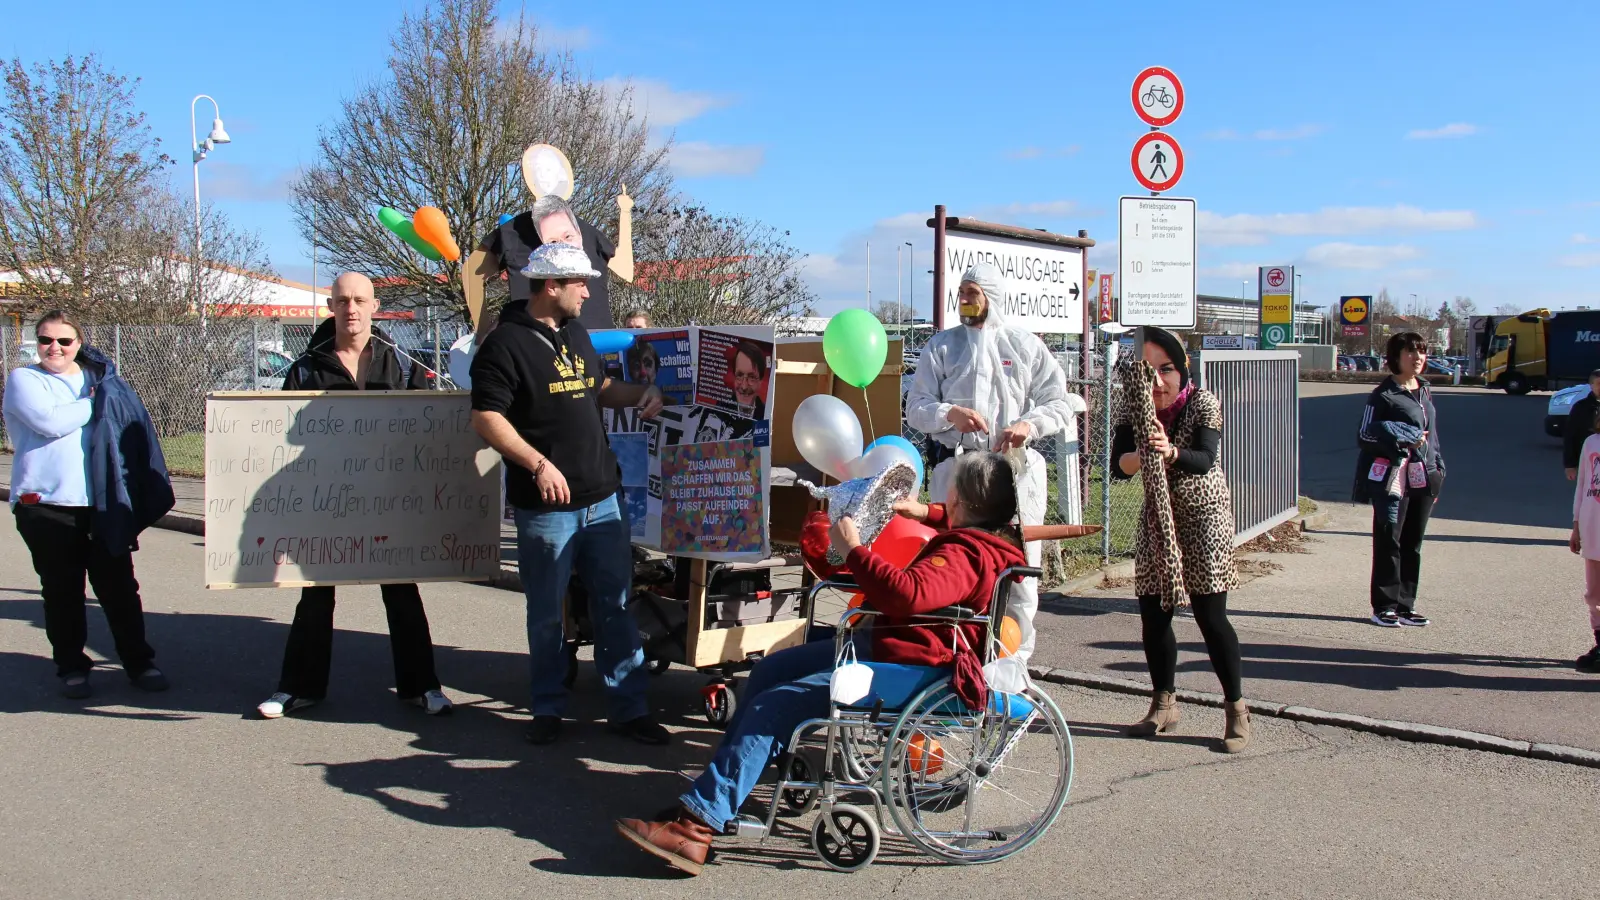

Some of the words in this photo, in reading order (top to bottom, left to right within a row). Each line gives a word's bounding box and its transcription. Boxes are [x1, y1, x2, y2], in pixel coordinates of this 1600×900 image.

[1130, 260, 1143, 274] 10
[675, 340, 690, 352] Wir
[659, 353, 691, 367] schaffen
[677, 367, 692, 379] DAS
[549, 381, 565, 394] EDEL
[208, 406, 240, 433] Nur
[251, 407, 283, 436] eine
[354, 417, 382, 436] nur
[388, 407, 417, 436] eine
[423, 405, 472, 440] Spritz
[208, 458, 237, 477] nur
[241, 444, 265, 473] die
[343, 457, 371, 476] nur
[375, 443, 404, 472] die
[688, 457, 736, 471] ZUSAMMEN
[671, 473, 714, 486] SCHAFFEN
[716, 472, 732, 484] WIR
[670, 487, 696, 499] BLEIBT
[697, 486, 736, 498] ZUHAUSE
[737, 485, 755, 496] UND
[208, 497, 237, 519] nur
[373, 494, 400, 516] nur
[401, 486, 423, 515] ein
[434, 482, 489, 519] Krieg
[676, 501, 703, 512] PASST
[704, 499, 749, 511] AUFEINDER
[207, 551, 237, 571] nur
[240, 549, 270, 567] wir
[272, 536, 365, 566] GEMEINSAM
[420, 543, 436, 562] es
